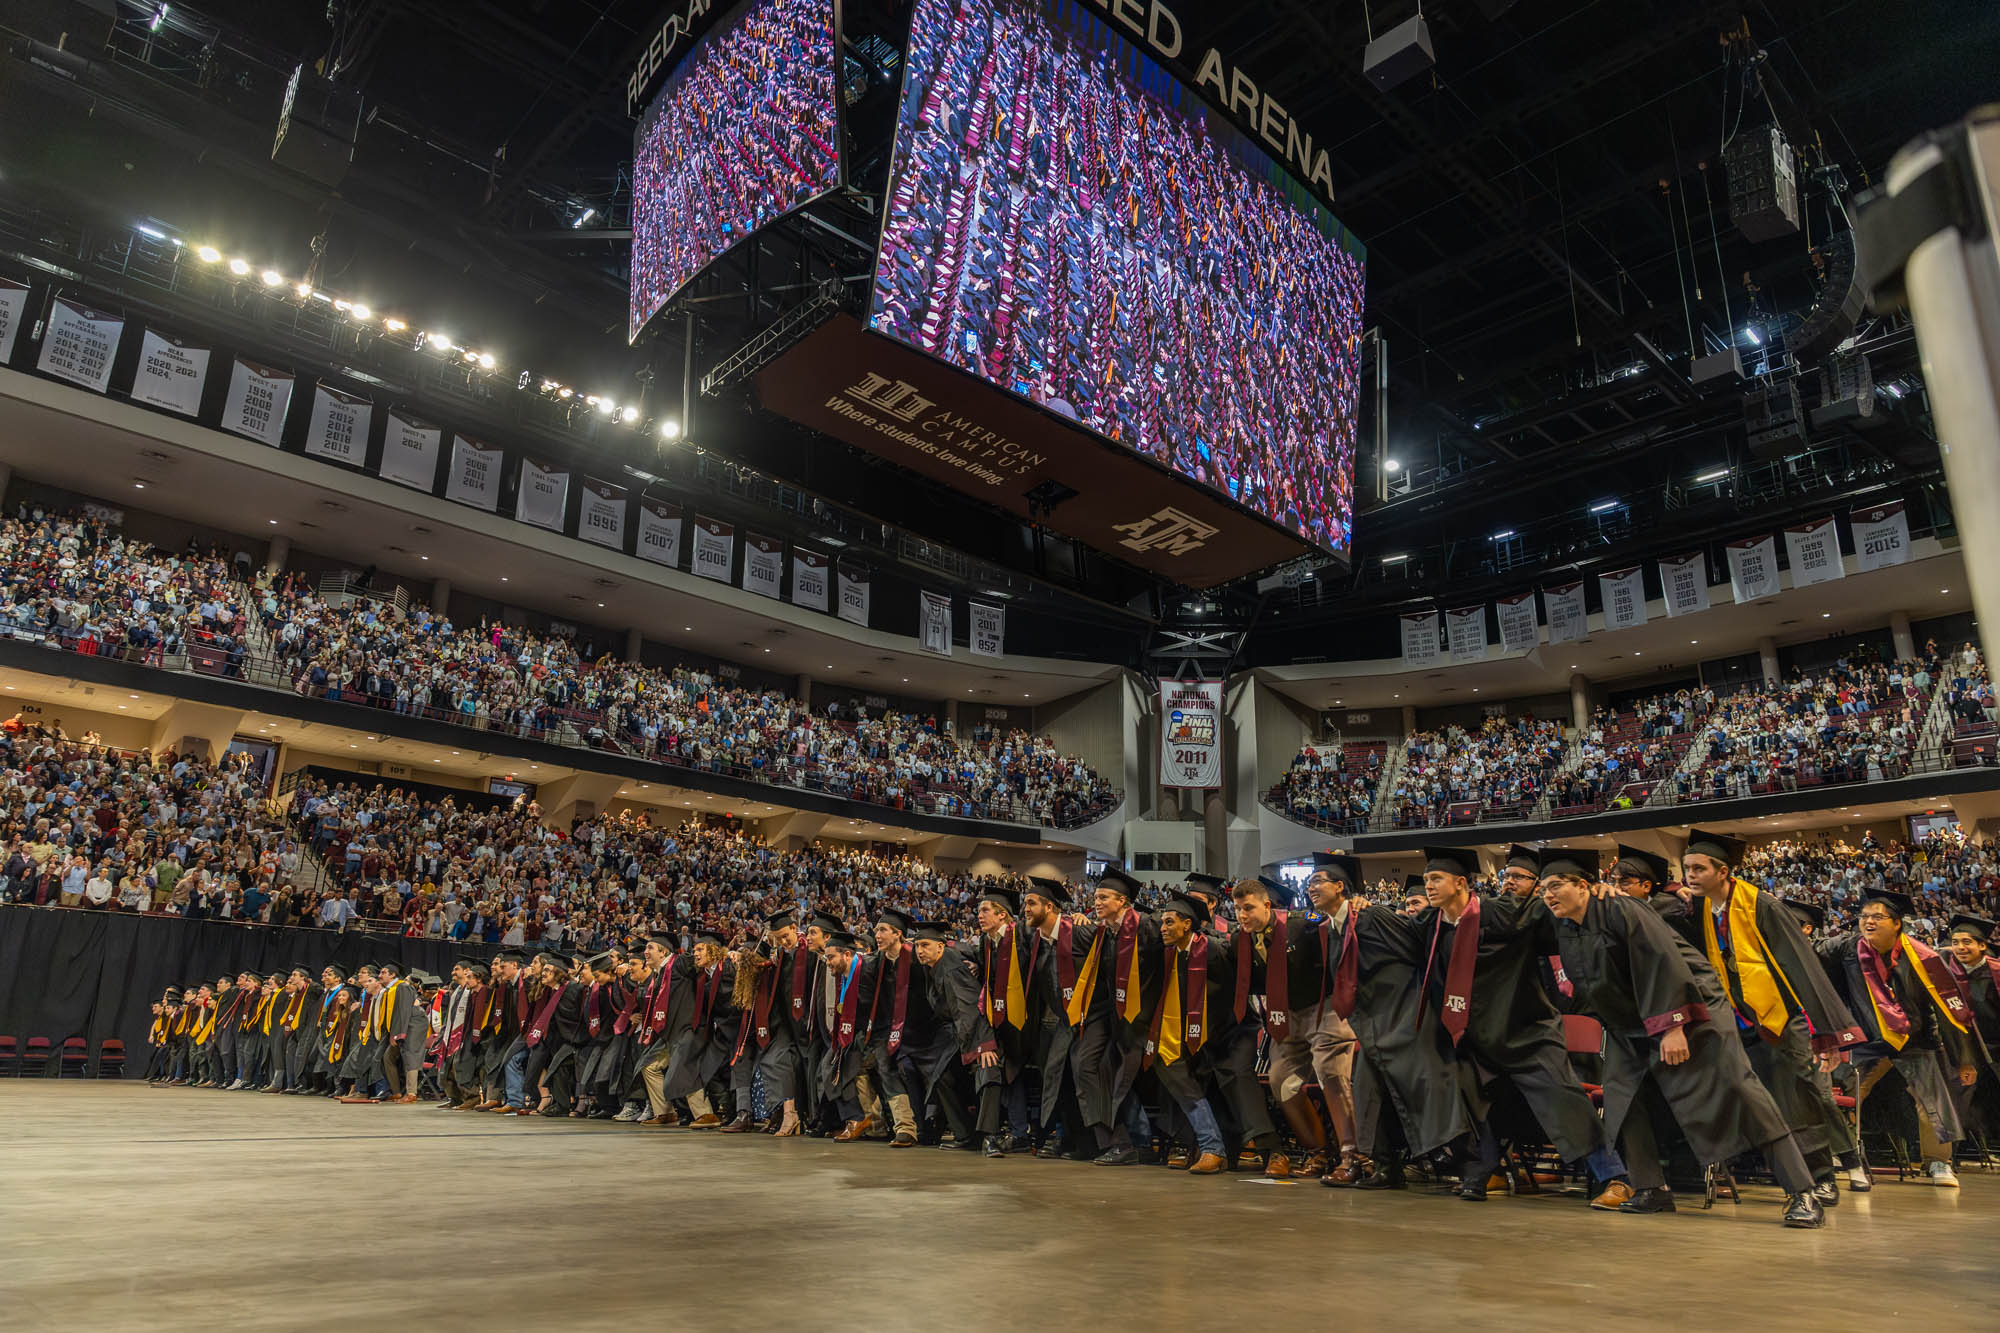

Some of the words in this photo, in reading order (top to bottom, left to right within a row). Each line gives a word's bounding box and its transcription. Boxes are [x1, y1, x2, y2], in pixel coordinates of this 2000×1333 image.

[628, 14, 678, 117] REED
[1195, 48, 1335, 201] ARENA
[825, 396, 877, 426] Where
[875, 422, 938, 454] students
[936, 448, 968, 467] love
[965, 462, 1003, 485] living.
[935, 412, 1047, 466] AMERICAN
[921, 421, 1031, 474] CAMPUS
[587, 512, 617, 532] 1996
[645, 531, 673, 550] 2007
[1865, 536, 1900, 555] 2015
[699, 549, 727, 567] 2008
[1802, 550, 1825, 561] 2001
[752, 566, 774, 582] 2010
[800, 580, 822, 596] 2013
[844, 592, 864, 609] 2021
[977, 619, 996, 631] 2011
[978, 639, 996, 652] 852
[719, 664, 740, 679] 207
[1172, 690, 1210, 700] NATIONAL
[22, 705, 42, 714] 104
[1166, 700, 1216, 710] CHAMPIONS
[1182, 714, 1213, 727] FINAL
[1176, 750, 1206, 764] 2011
[1189, 1024, 1200, 1034] 150
